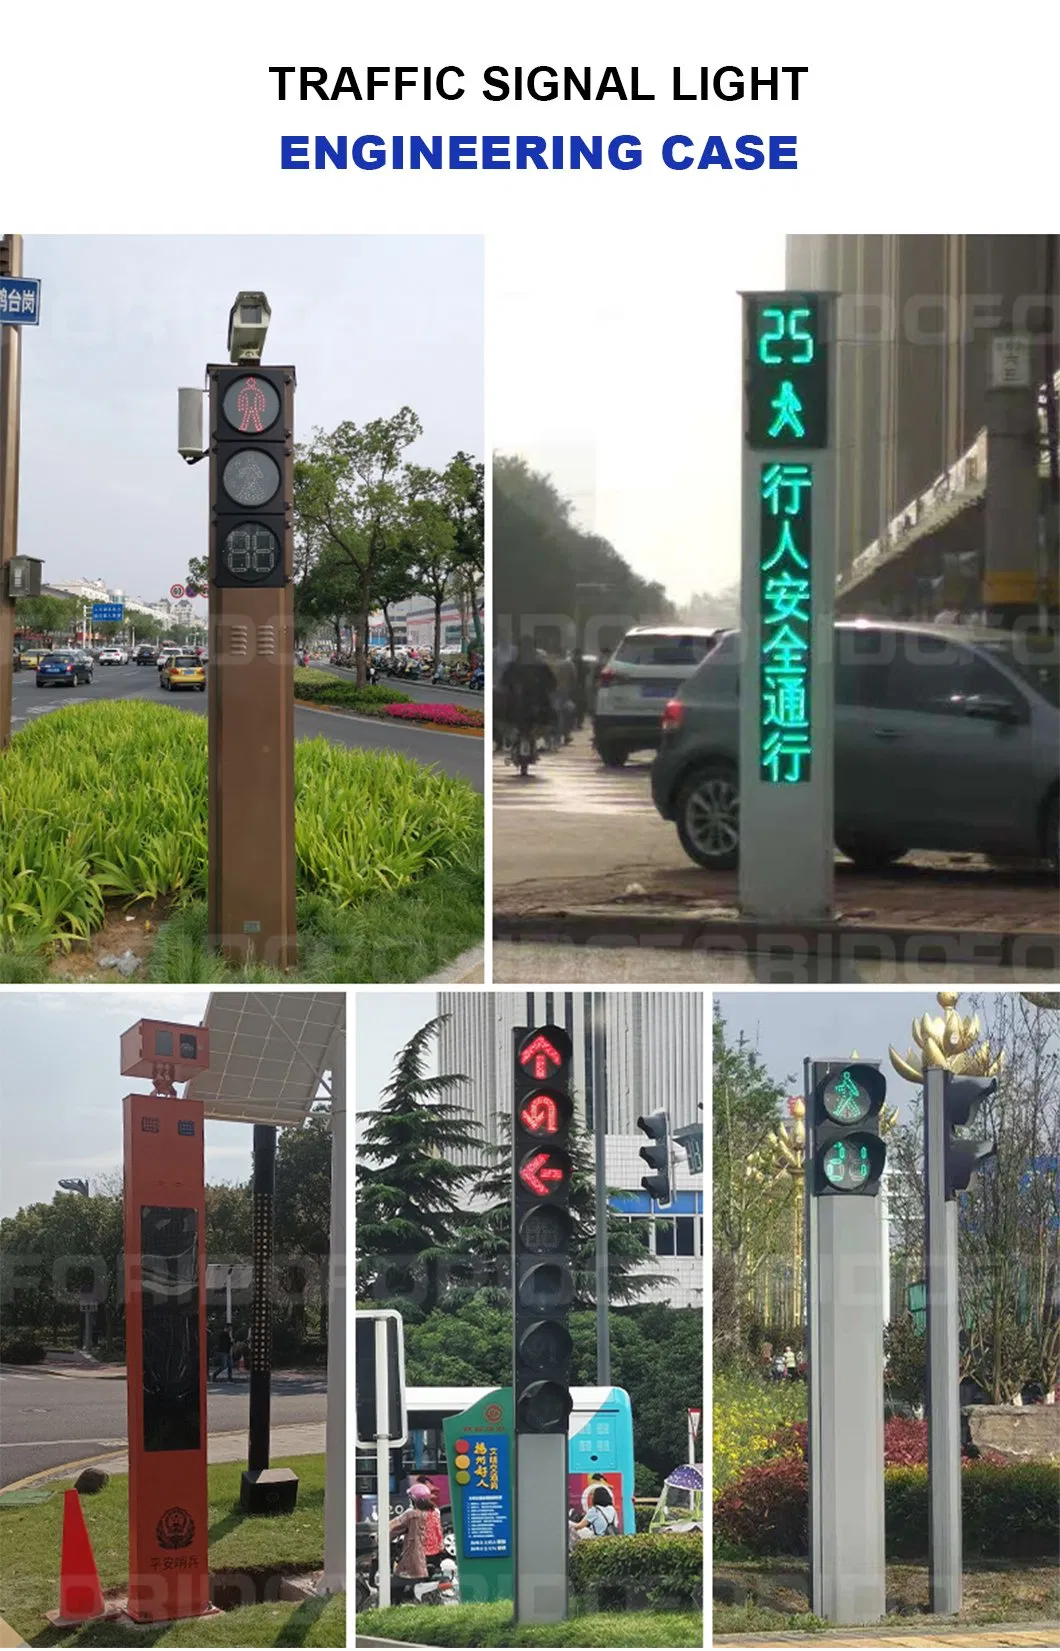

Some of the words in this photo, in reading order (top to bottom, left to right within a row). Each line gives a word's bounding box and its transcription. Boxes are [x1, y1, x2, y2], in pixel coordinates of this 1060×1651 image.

[759, 308, 814, 364] 25
[760, 463, 812, 784] 行人安全通行
[150, 1556, 200, 1571] 平安哨兵
